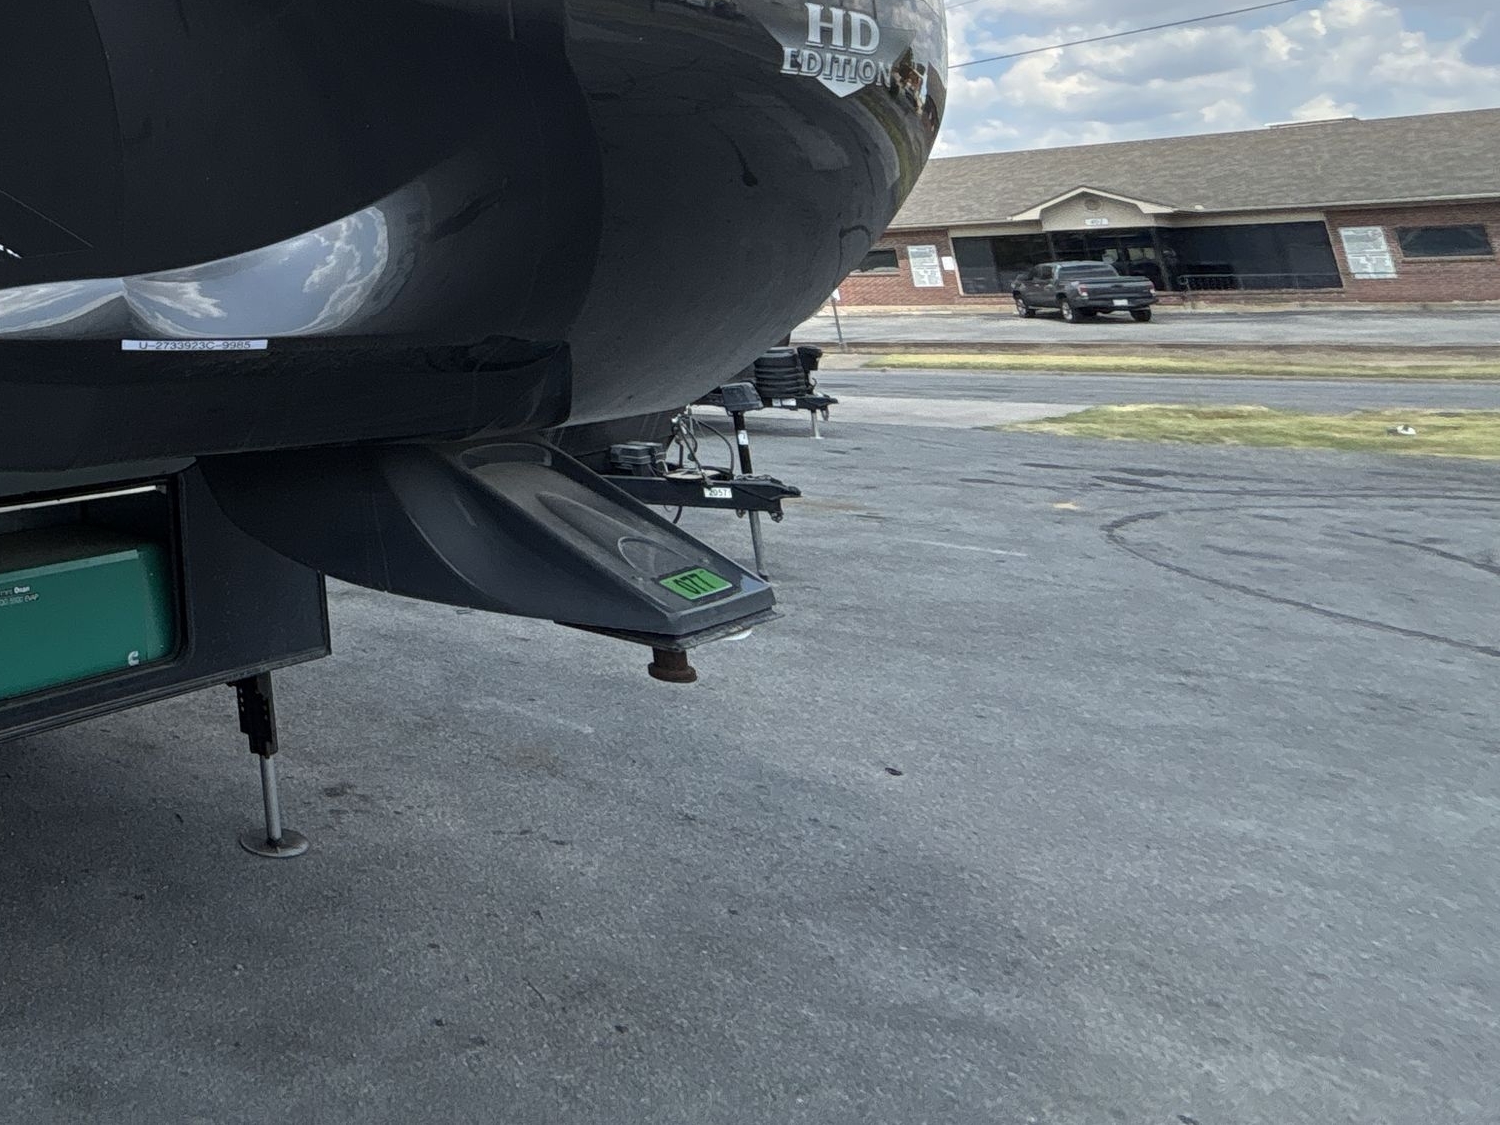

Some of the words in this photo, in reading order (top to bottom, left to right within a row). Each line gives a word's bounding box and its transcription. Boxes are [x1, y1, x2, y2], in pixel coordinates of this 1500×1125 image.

[804, 2, 880, 55] HD
[780, 46, 893, 88] EDITION
[138, 340, 251, 350] U-2733923C-9985
